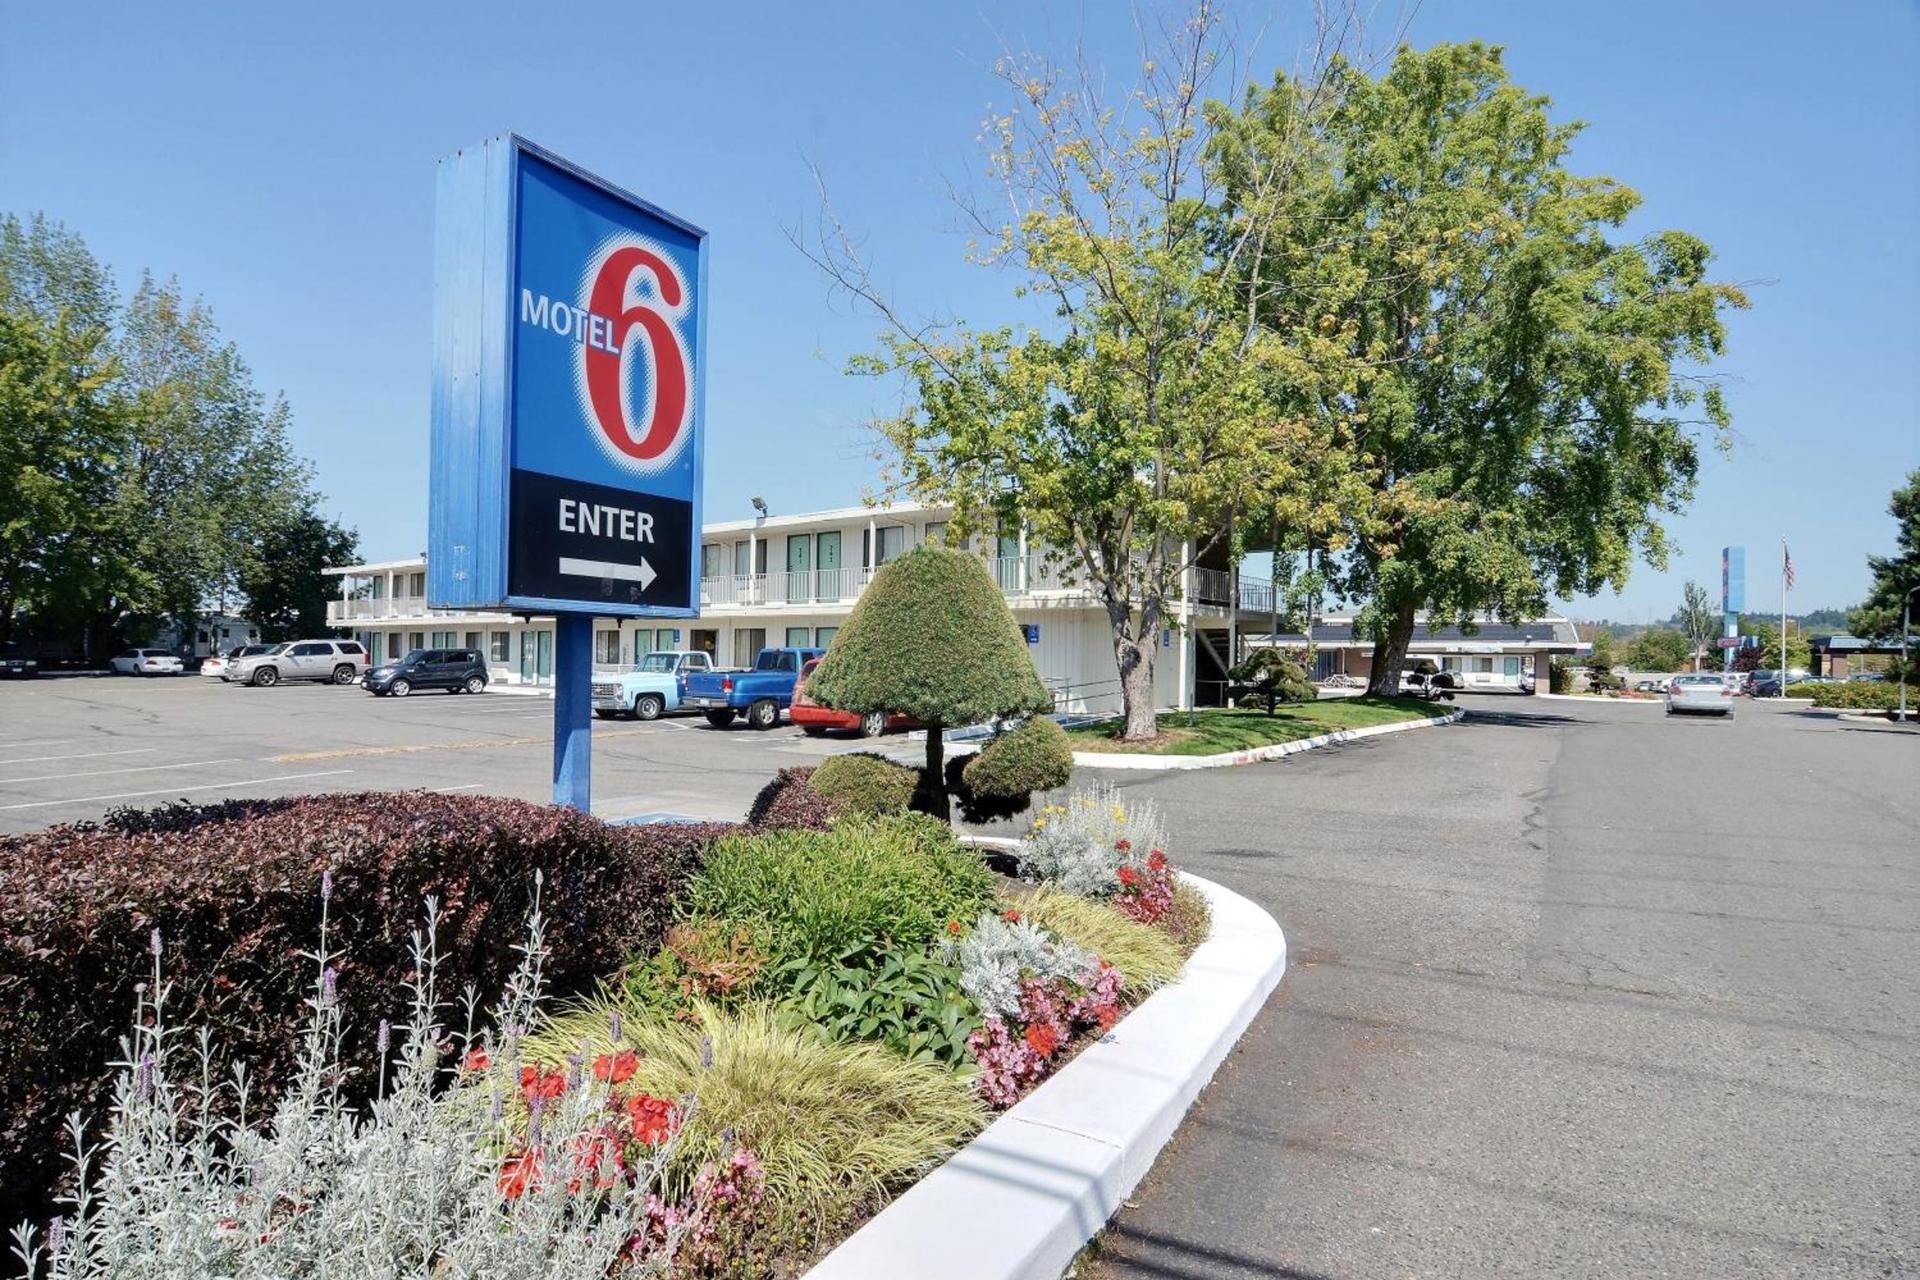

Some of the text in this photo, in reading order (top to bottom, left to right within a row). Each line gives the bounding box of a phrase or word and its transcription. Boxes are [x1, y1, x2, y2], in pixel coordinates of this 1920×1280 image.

[521, 246, 687, 461] MOTEL 6
[559, 498, 655, 544] ENTER
